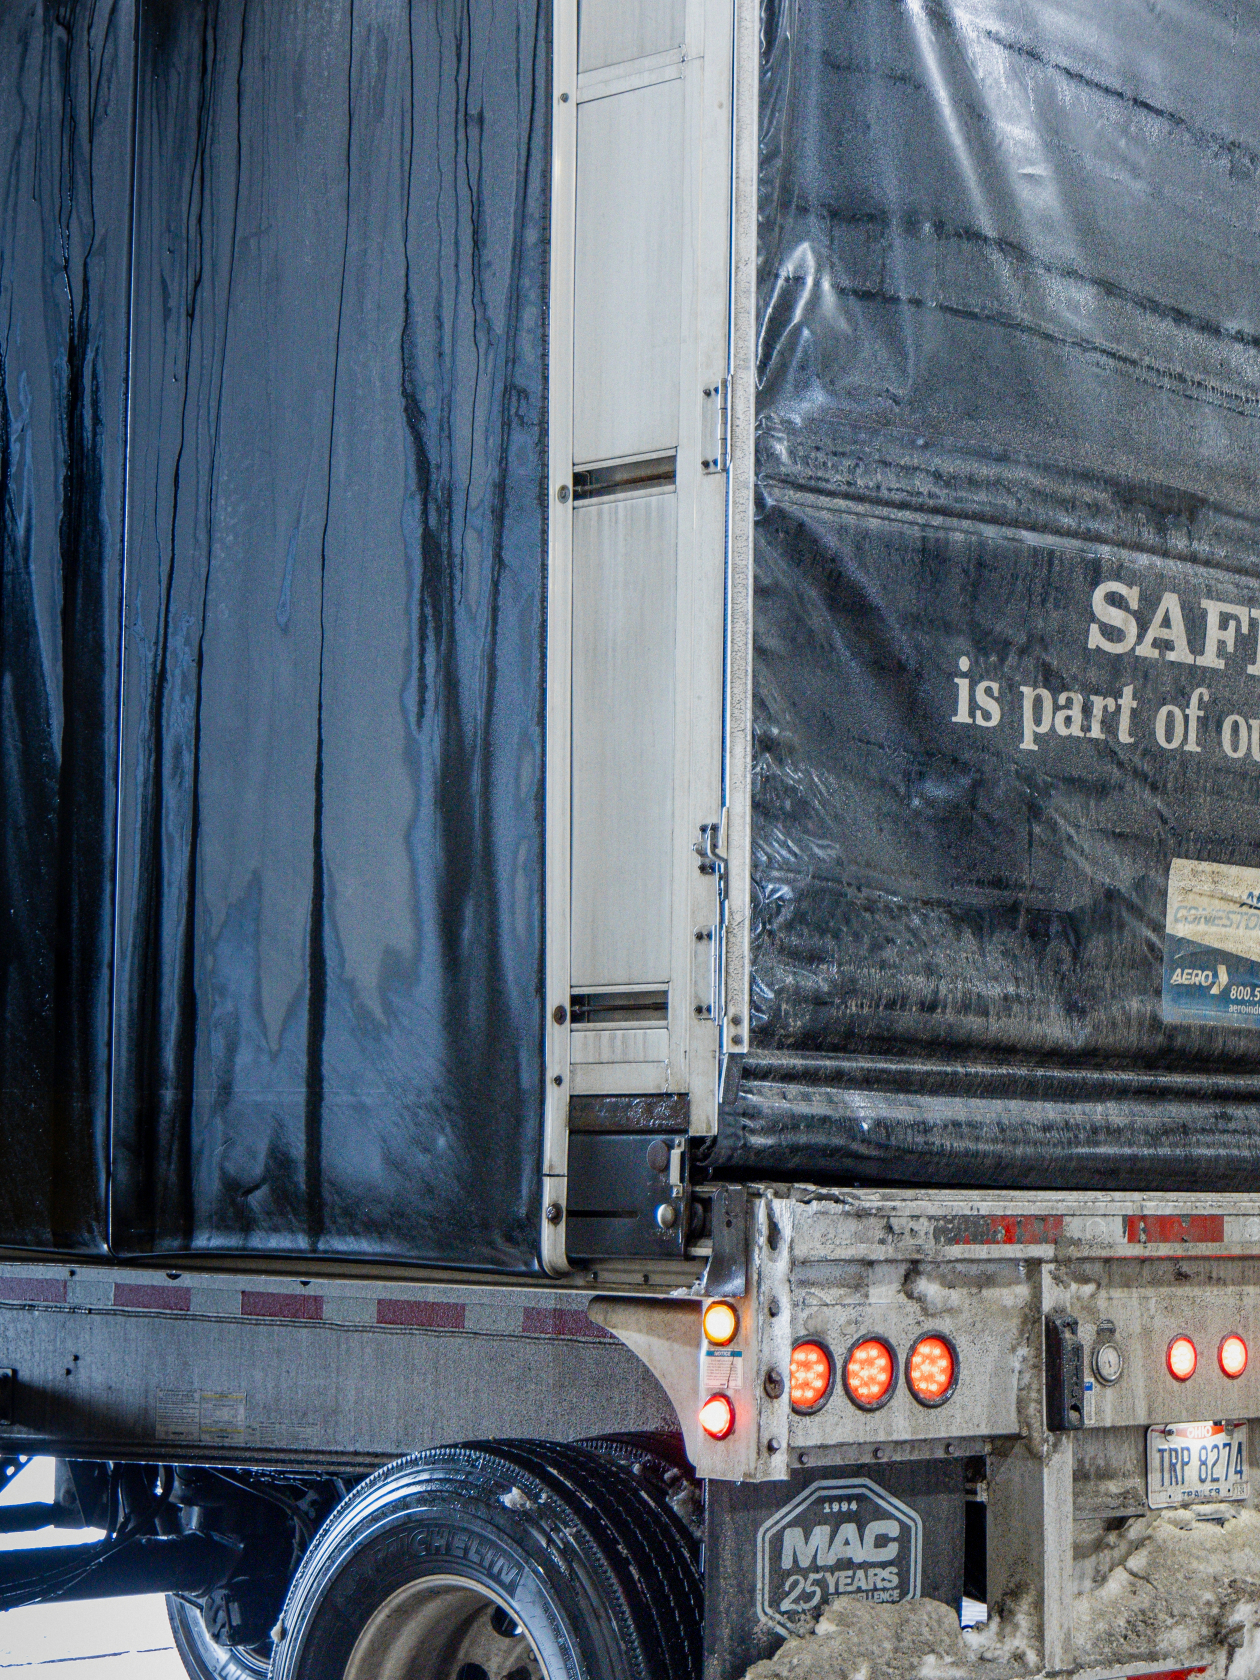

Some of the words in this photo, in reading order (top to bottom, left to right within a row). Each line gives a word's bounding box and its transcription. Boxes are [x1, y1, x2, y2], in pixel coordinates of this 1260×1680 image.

[951, 657, 1001, 727] is
[1019, 683, 1137, 750] part
[1155, 687, 1209, 752] of
[1170, 968, 1212, 986] AERO
[1187, 1426, 1212, 1438] OHIO
[1157, 1445, 1191, 1488] TRP
[1199, 1441, 1243, 1483] 8274
[823, 1501, 858, 1513] 1994
[1181, 1488, 1221, 1498] TRAILER
[781, 1520, 900, 1569] MAC
[780, 1572, 824, 1612] 25
[824, 1566, 899, 1593] YEARS
